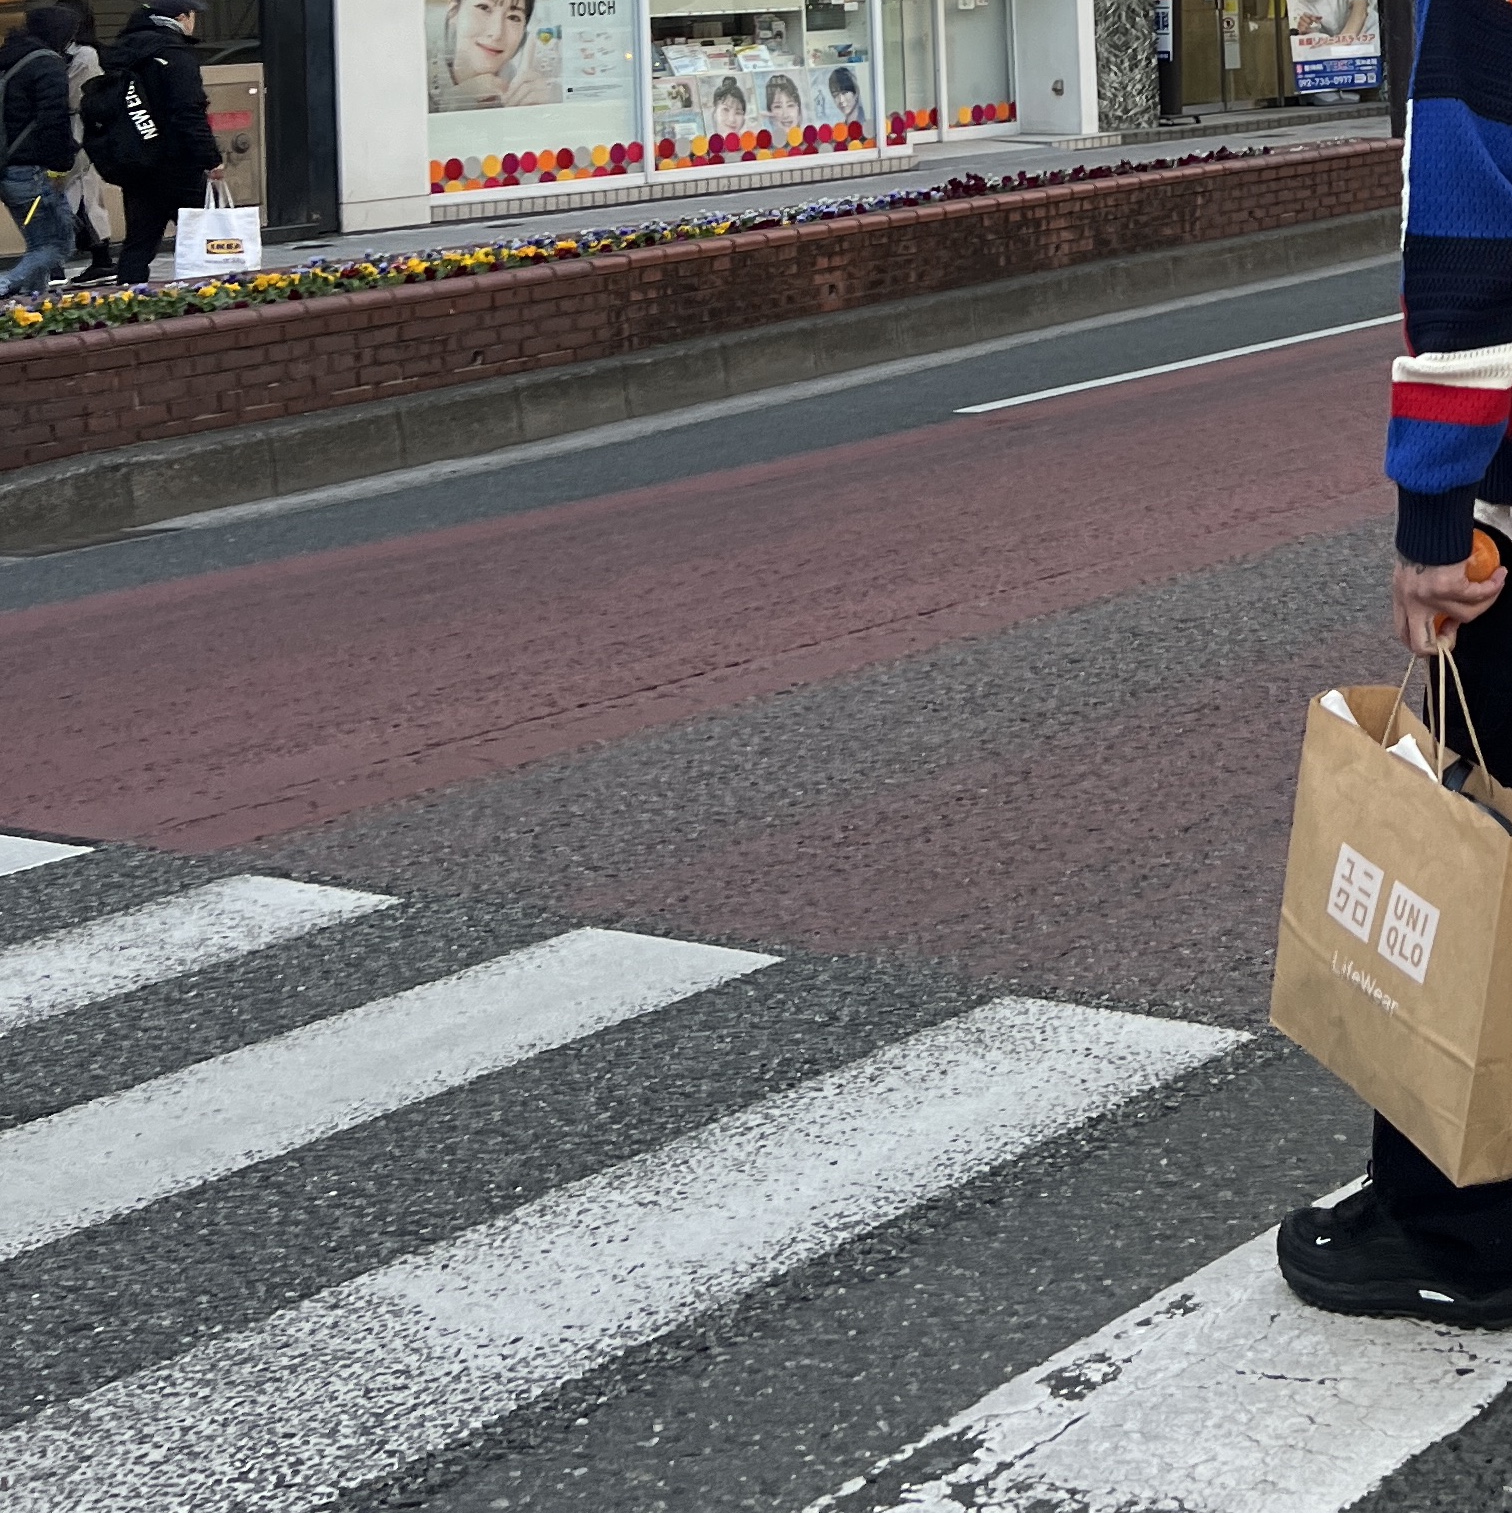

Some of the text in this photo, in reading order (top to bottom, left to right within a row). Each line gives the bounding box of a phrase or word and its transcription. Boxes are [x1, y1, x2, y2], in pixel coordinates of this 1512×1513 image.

[568, 0, 616, 17] TOUCH
[128, 109, 160, 141] NEW
[210, 242, 242, 250] IKEA
[1340, 857, 1376, 898] ユニ
[1334, 888, 1368, 928] クロ
[1392, 894, 1426, 937] UNI
[1386, 925, 1423, 969] QLO
[1331, 950, 1400, 1016] LifeWear
